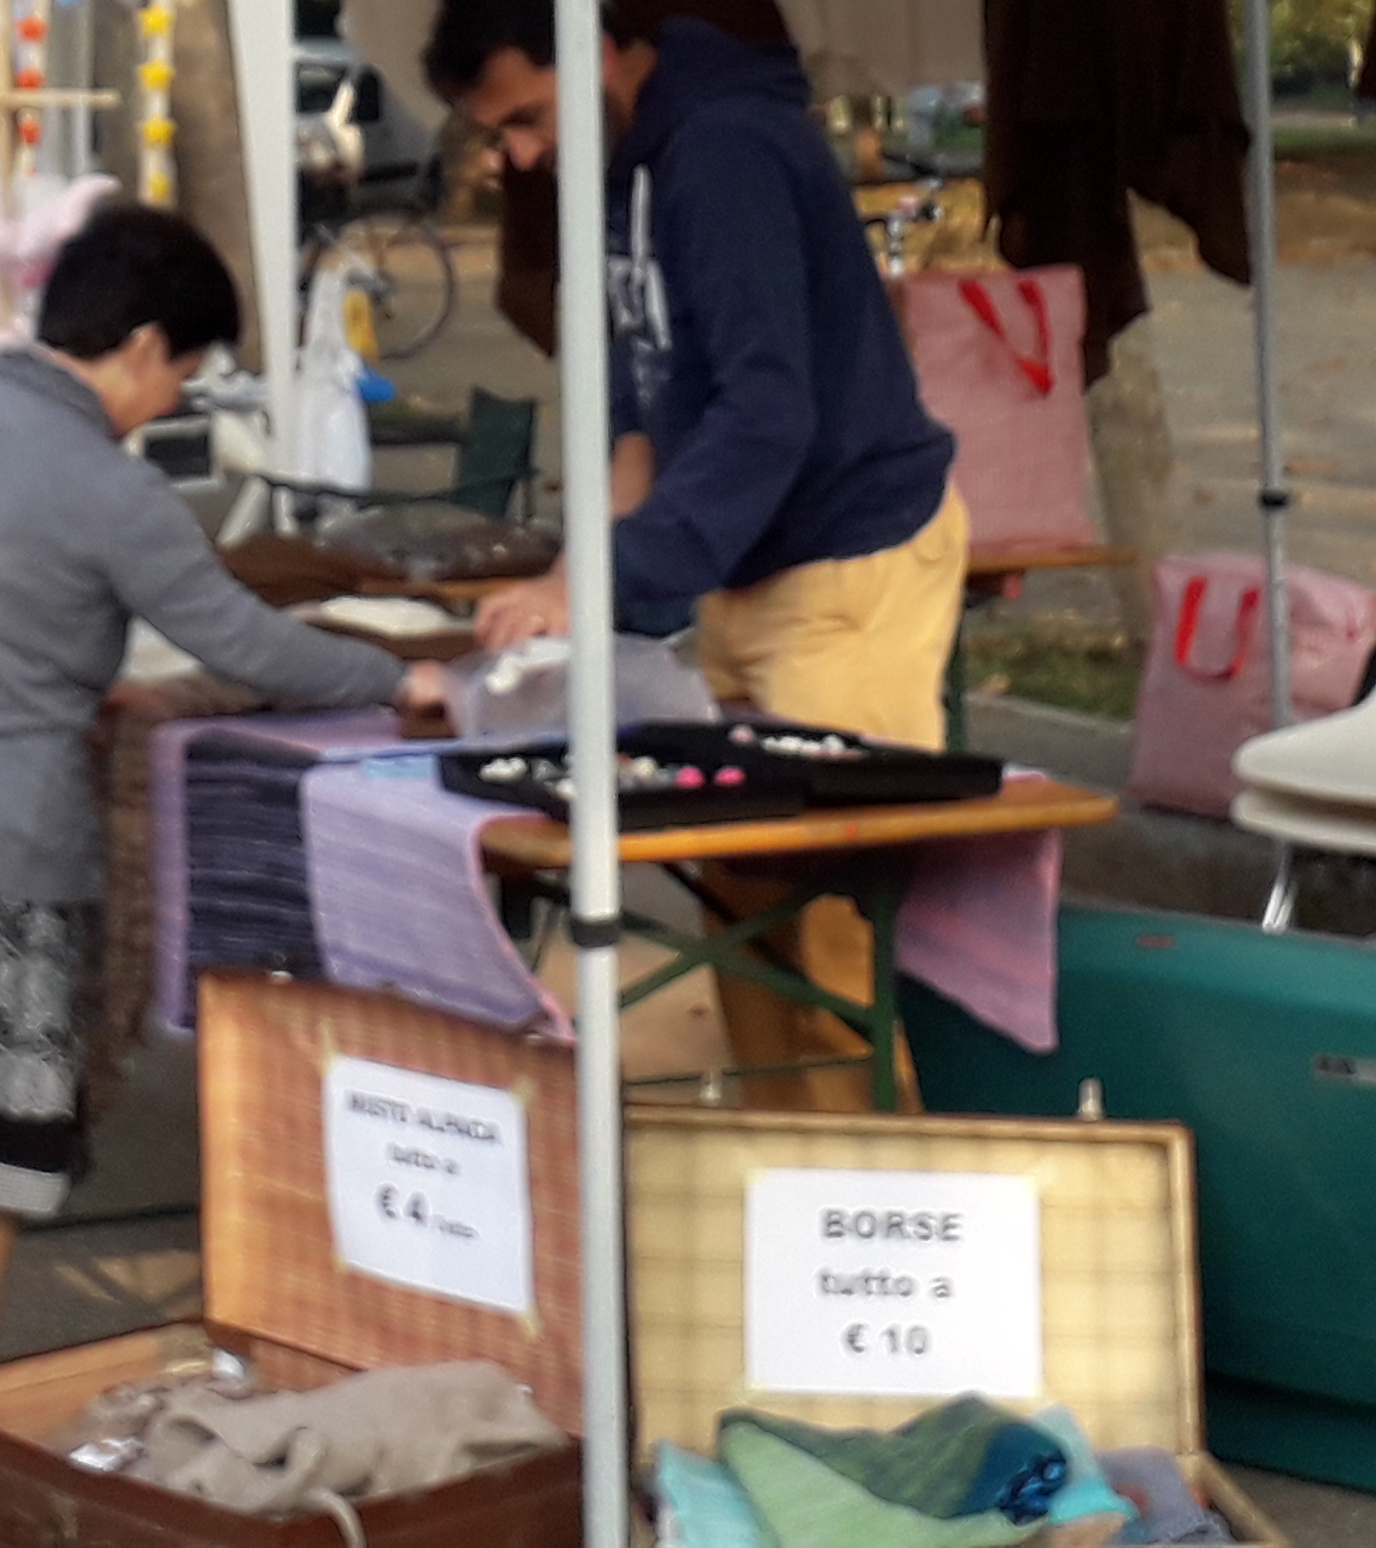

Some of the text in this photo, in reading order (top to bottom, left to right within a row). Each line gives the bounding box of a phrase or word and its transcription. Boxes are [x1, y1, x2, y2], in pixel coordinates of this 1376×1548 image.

[824, 1209, 965, 1242] BORSE
[820, 1267, 953, 1299] tutto a
[881, 1324, 931, 1356] 10
